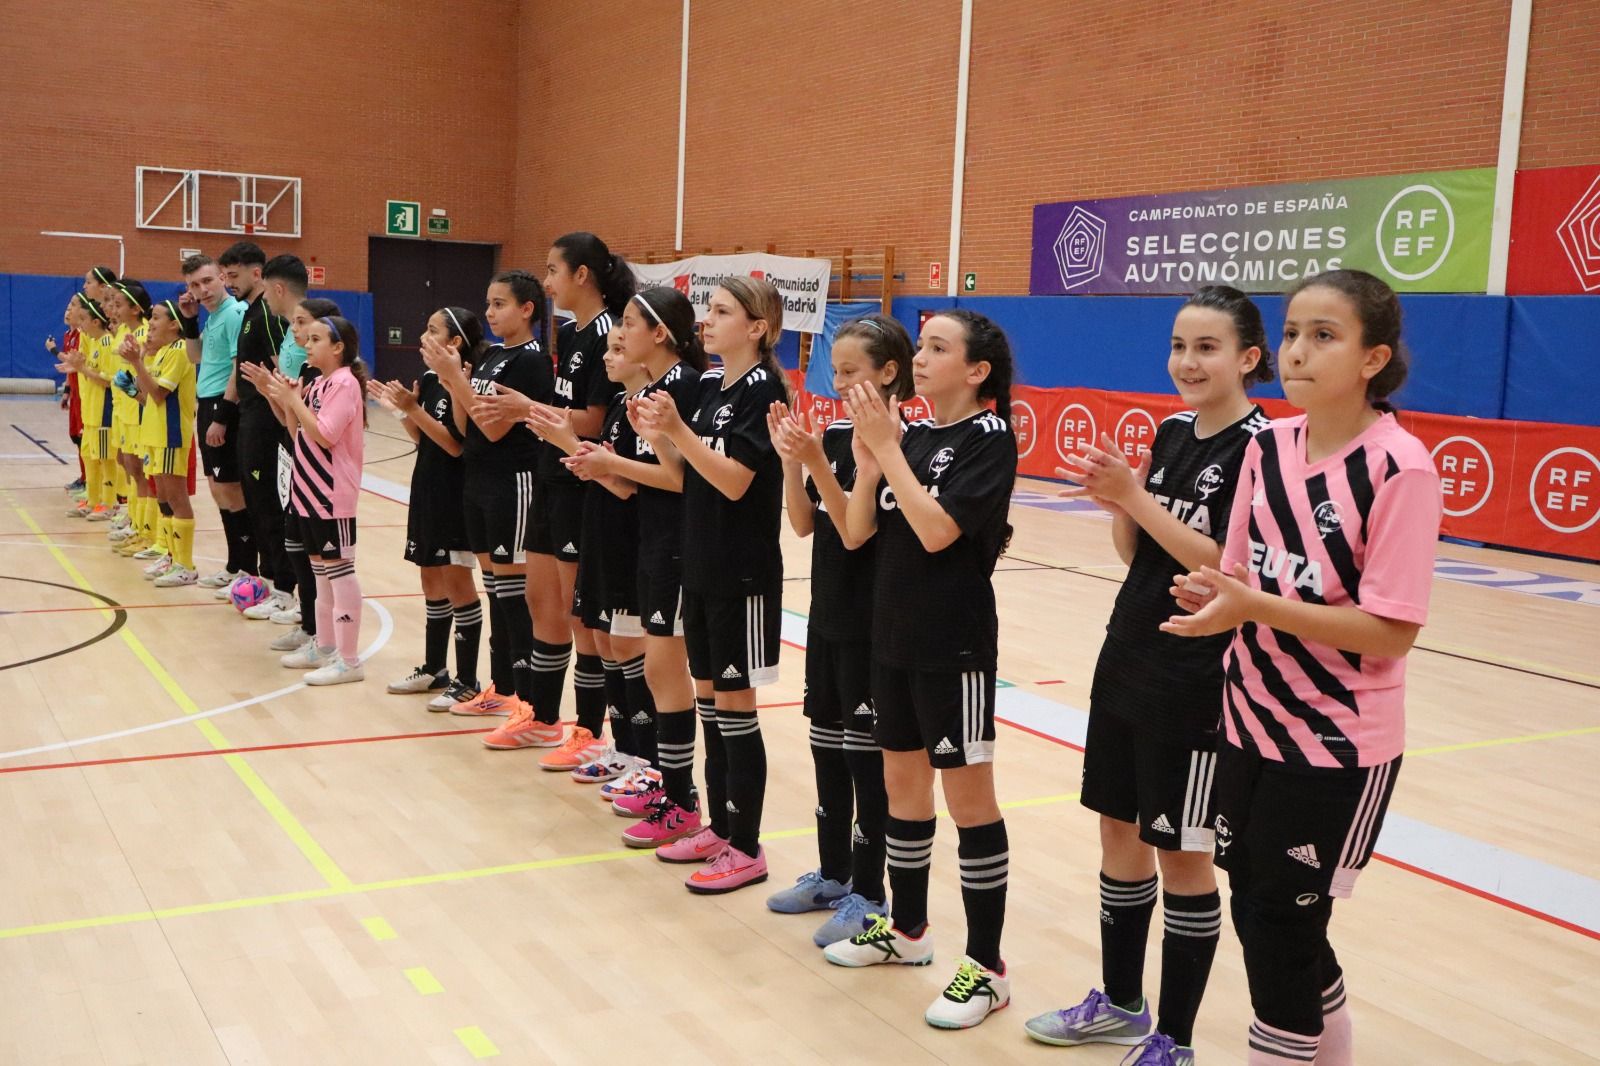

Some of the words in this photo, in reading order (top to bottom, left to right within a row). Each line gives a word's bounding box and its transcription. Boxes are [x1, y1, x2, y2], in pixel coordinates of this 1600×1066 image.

[1129, 204, 1238, 222] CAMPEONATO
[1244, 201, 1268, 215] DE
[1273, 193, 1349, 213] ESPAÑA
[1396, 208, 1438, 230] RF
[1074, 238, 1085, 246] RF
[1074, 247, 1085, 255] EF
[1126, 226, 1347, 256] SELECCIONES
[1393, 236, 1435, 257] EF
[1124, 254, 1344, 283] AUTONÓMICAS
[691, 274, 733, 287] Comunid
[690, 292, 701, 304] de
[471, 378, 497, 396] EUTA
[815, 401, 830, 412] RF
[903, 406, 924, 418] RF
[1064, 419, 1087, 433] RF
[1125, 424, 1148, 439] RF
[1124, 442, 1147, 457] EF
[1442, 454, 1479, 474] RF
[1440, 477, 1476, 497] EF
[1548, 467, 1592, 488] RF
[1546, 491, 1589, 512] EF
[1248, 539, 1323, 597] EUTA
[1287, 848, 1321, 868] adidas
